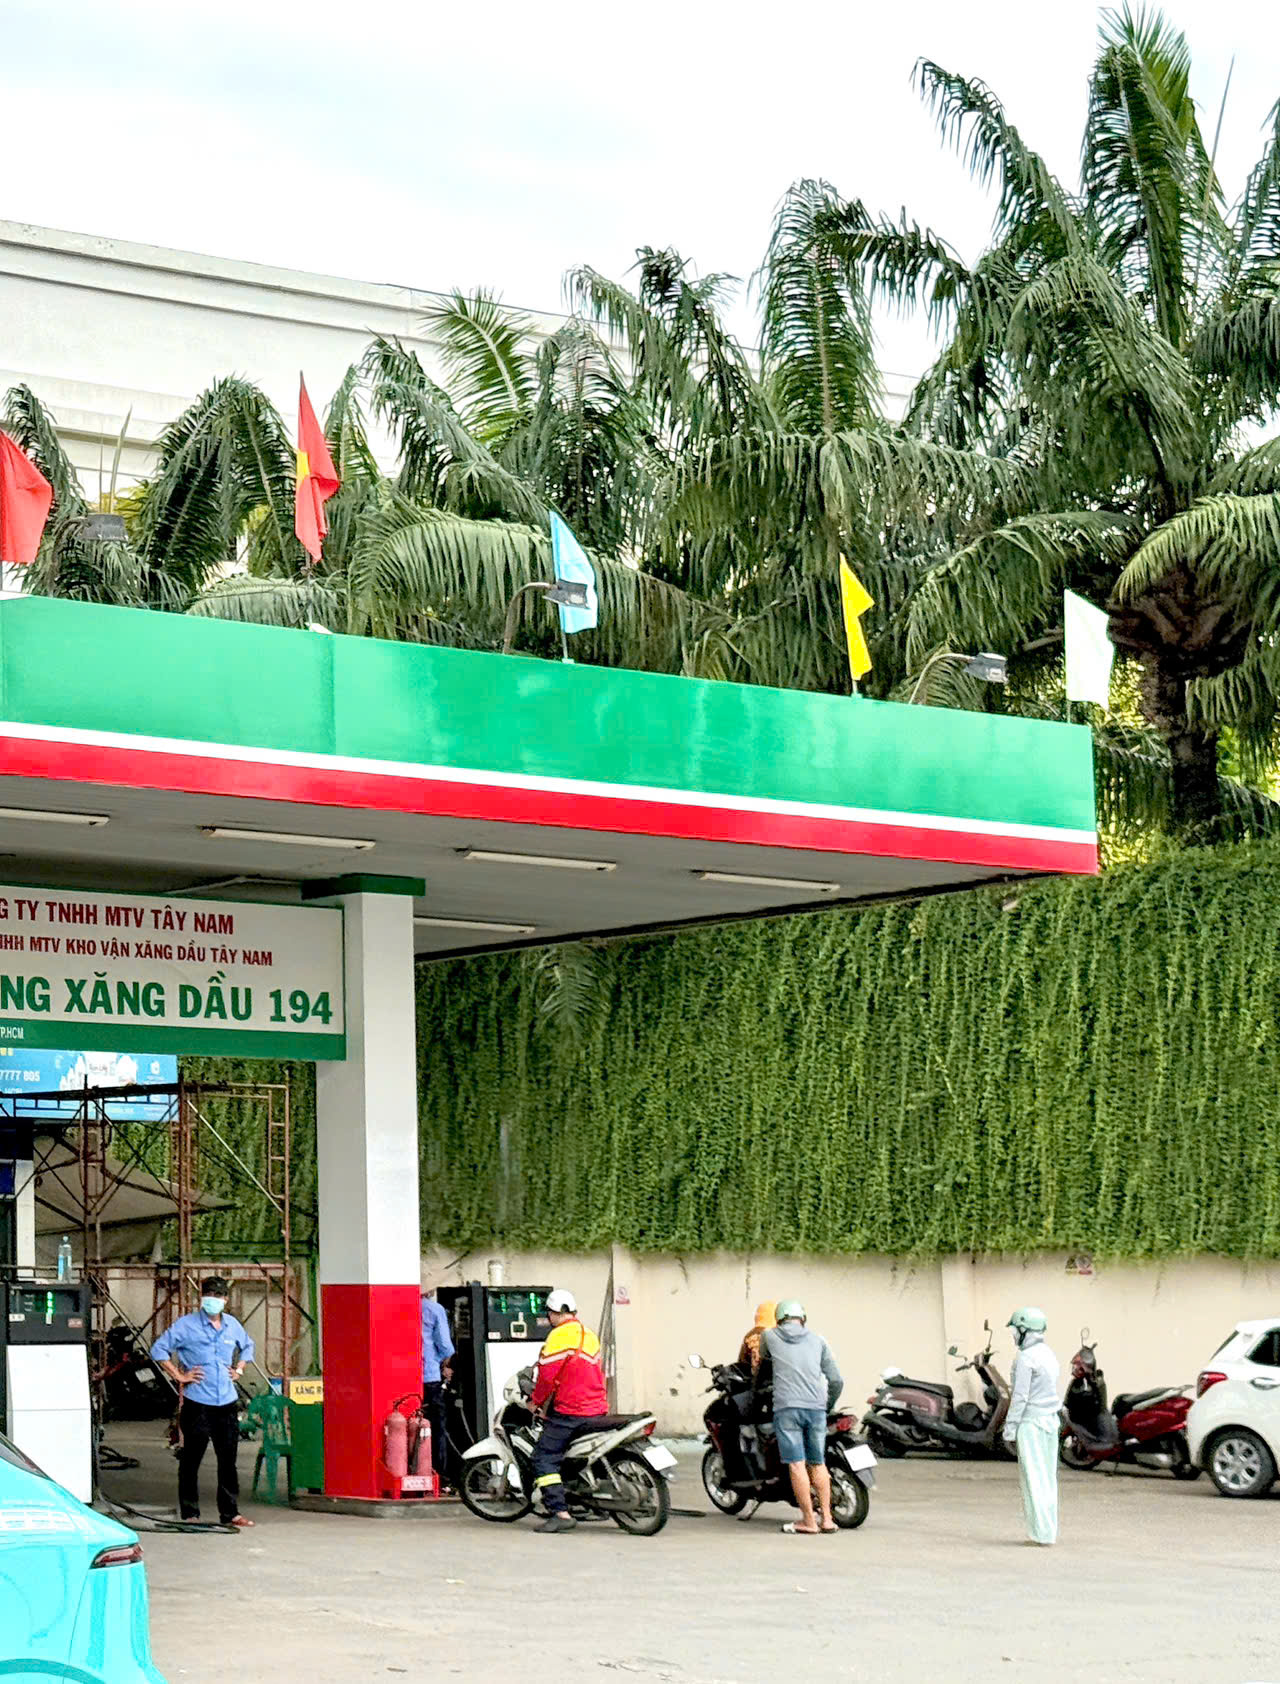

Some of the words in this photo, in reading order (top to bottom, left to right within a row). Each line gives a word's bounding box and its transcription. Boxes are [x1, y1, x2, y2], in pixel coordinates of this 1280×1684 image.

[14, 899, 39, 920] TY
[45, 901, 98, 925] TNHH
[105, 905, 144, 928] MTV
[151, 905, 187, 931] TÂY
[194, 912, 234, 935] NAM
[30, 936, 61, 954] MTV
[66, 938, 96, 956] KHO
[100, 937, 130, 960] VẬN
[134, 940, 173, 961] XĂNG
[177, 940, 206, 962] DẦU
[210, 945, 237, 965] TÂY
[243, 950, 273, 967] NAM
[64, 971, 165, 1018] XĂNG
[179, 971, 252, 1021] DẦU
[269, 988, 333, 1024] 194
